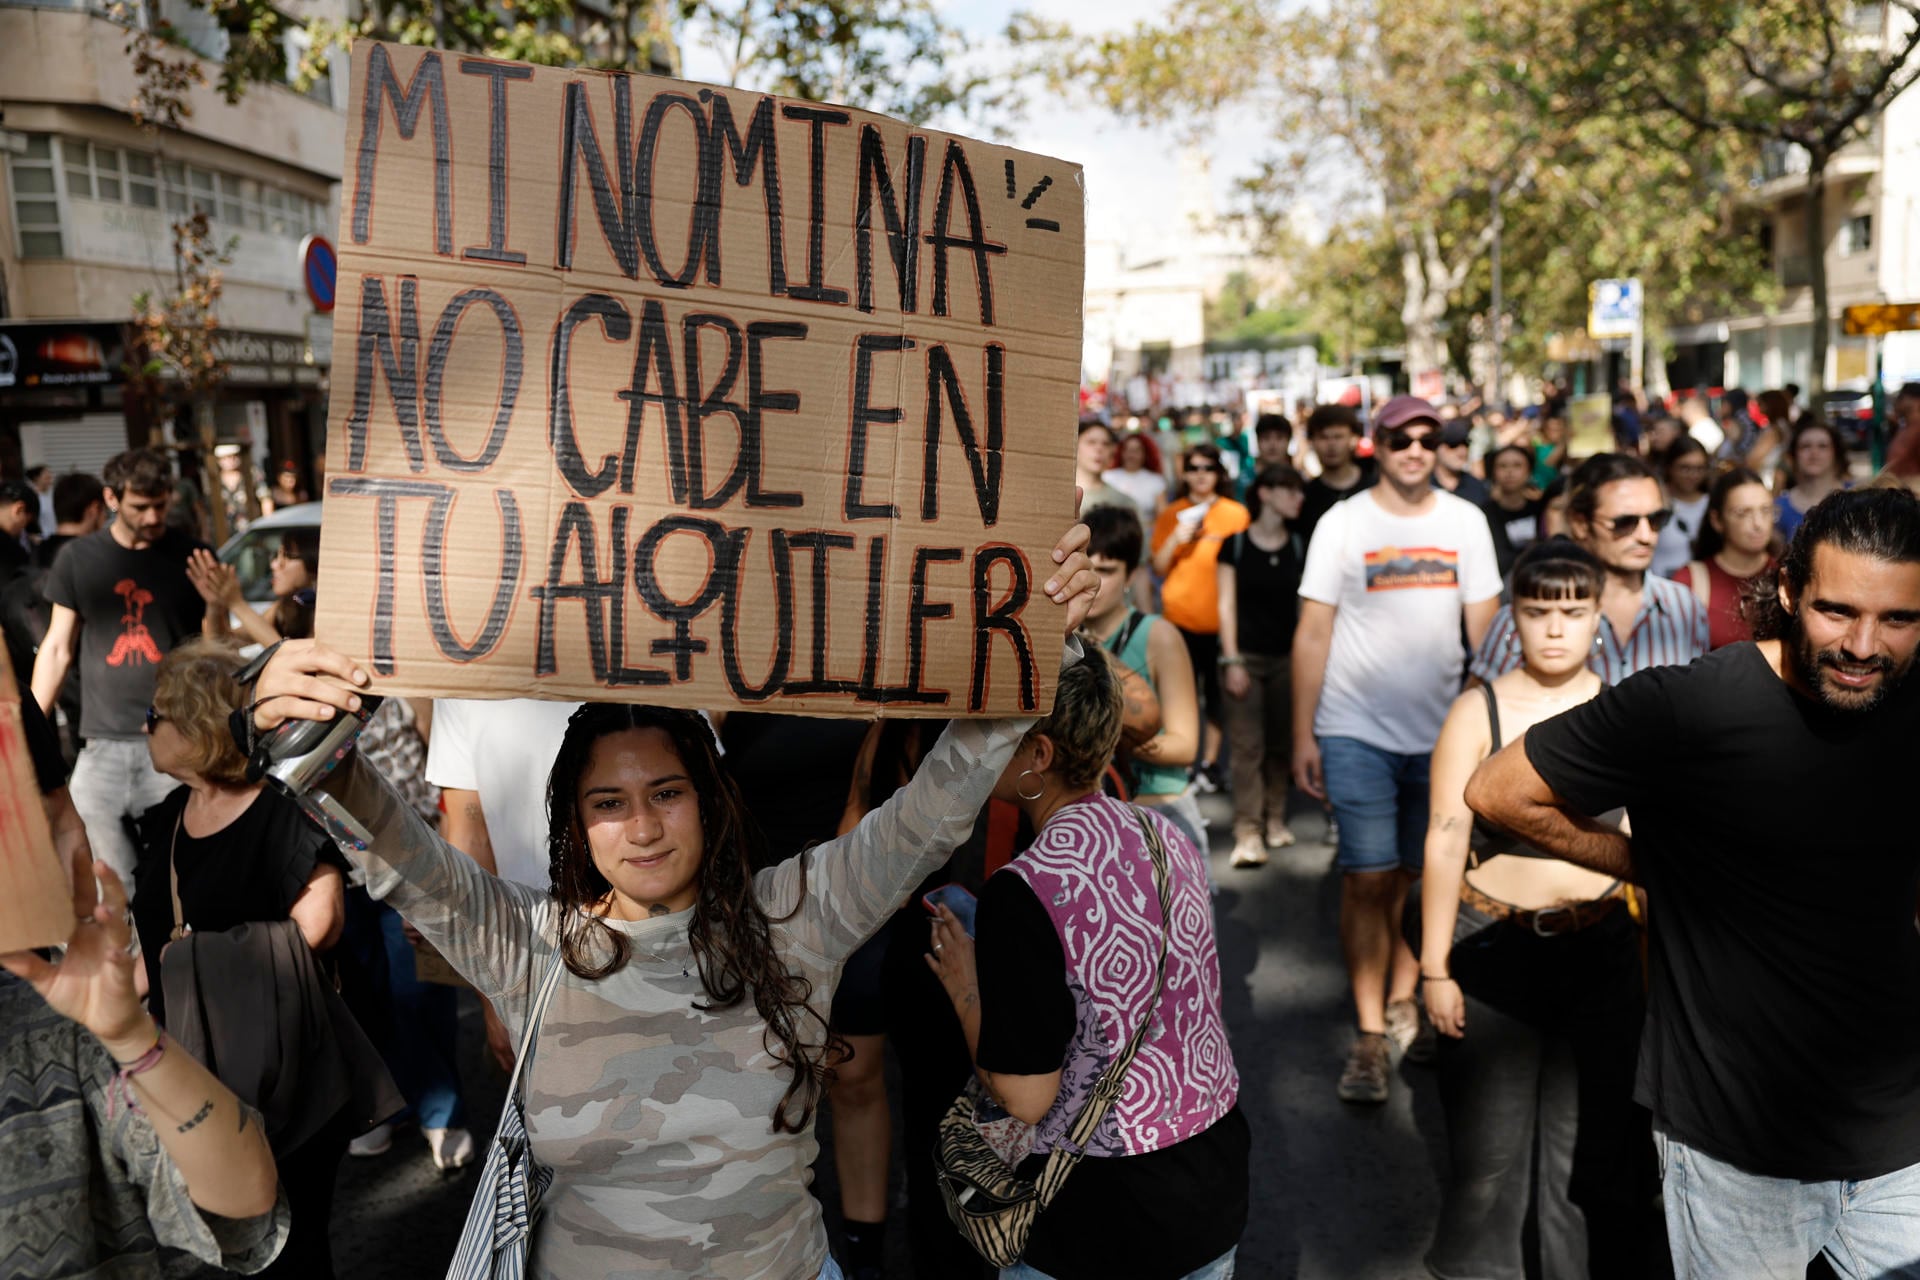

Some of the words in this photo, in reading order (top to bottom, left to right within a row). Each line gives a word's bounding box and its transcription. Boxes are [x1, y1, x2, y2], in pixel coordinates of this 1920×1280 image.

[352, 42, 535, 267] MI
[347, 273, 525, 473] NO
[550, 292, 808, 510] CABE
[844, 333, 1006, 526] EN
[328, 476, 525, 678] TU
[530, 500, 1038, 713] ALQUILER
